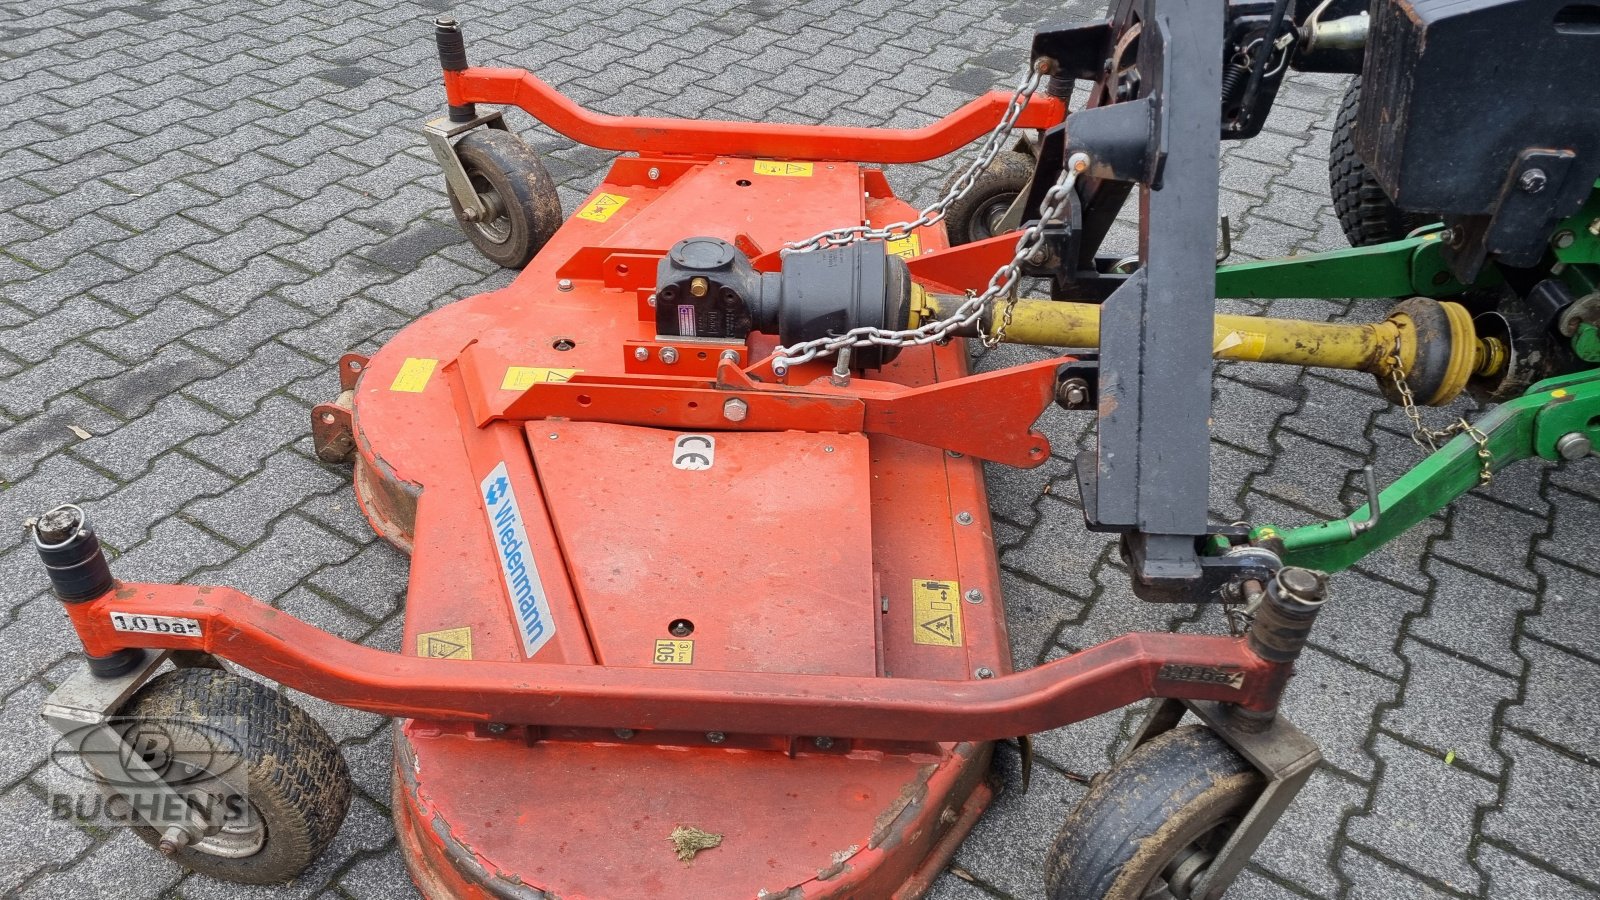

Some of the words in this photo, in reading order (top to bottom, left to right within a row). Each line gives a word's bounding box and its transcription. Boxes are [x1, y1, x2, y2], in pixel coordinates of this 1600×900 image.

[676, 436, 711, 465] CE
[495, 499, 544, 644] Wiedenmann
[153, 617, 197, 634] bar
[657, 642, 675, 662] 105
